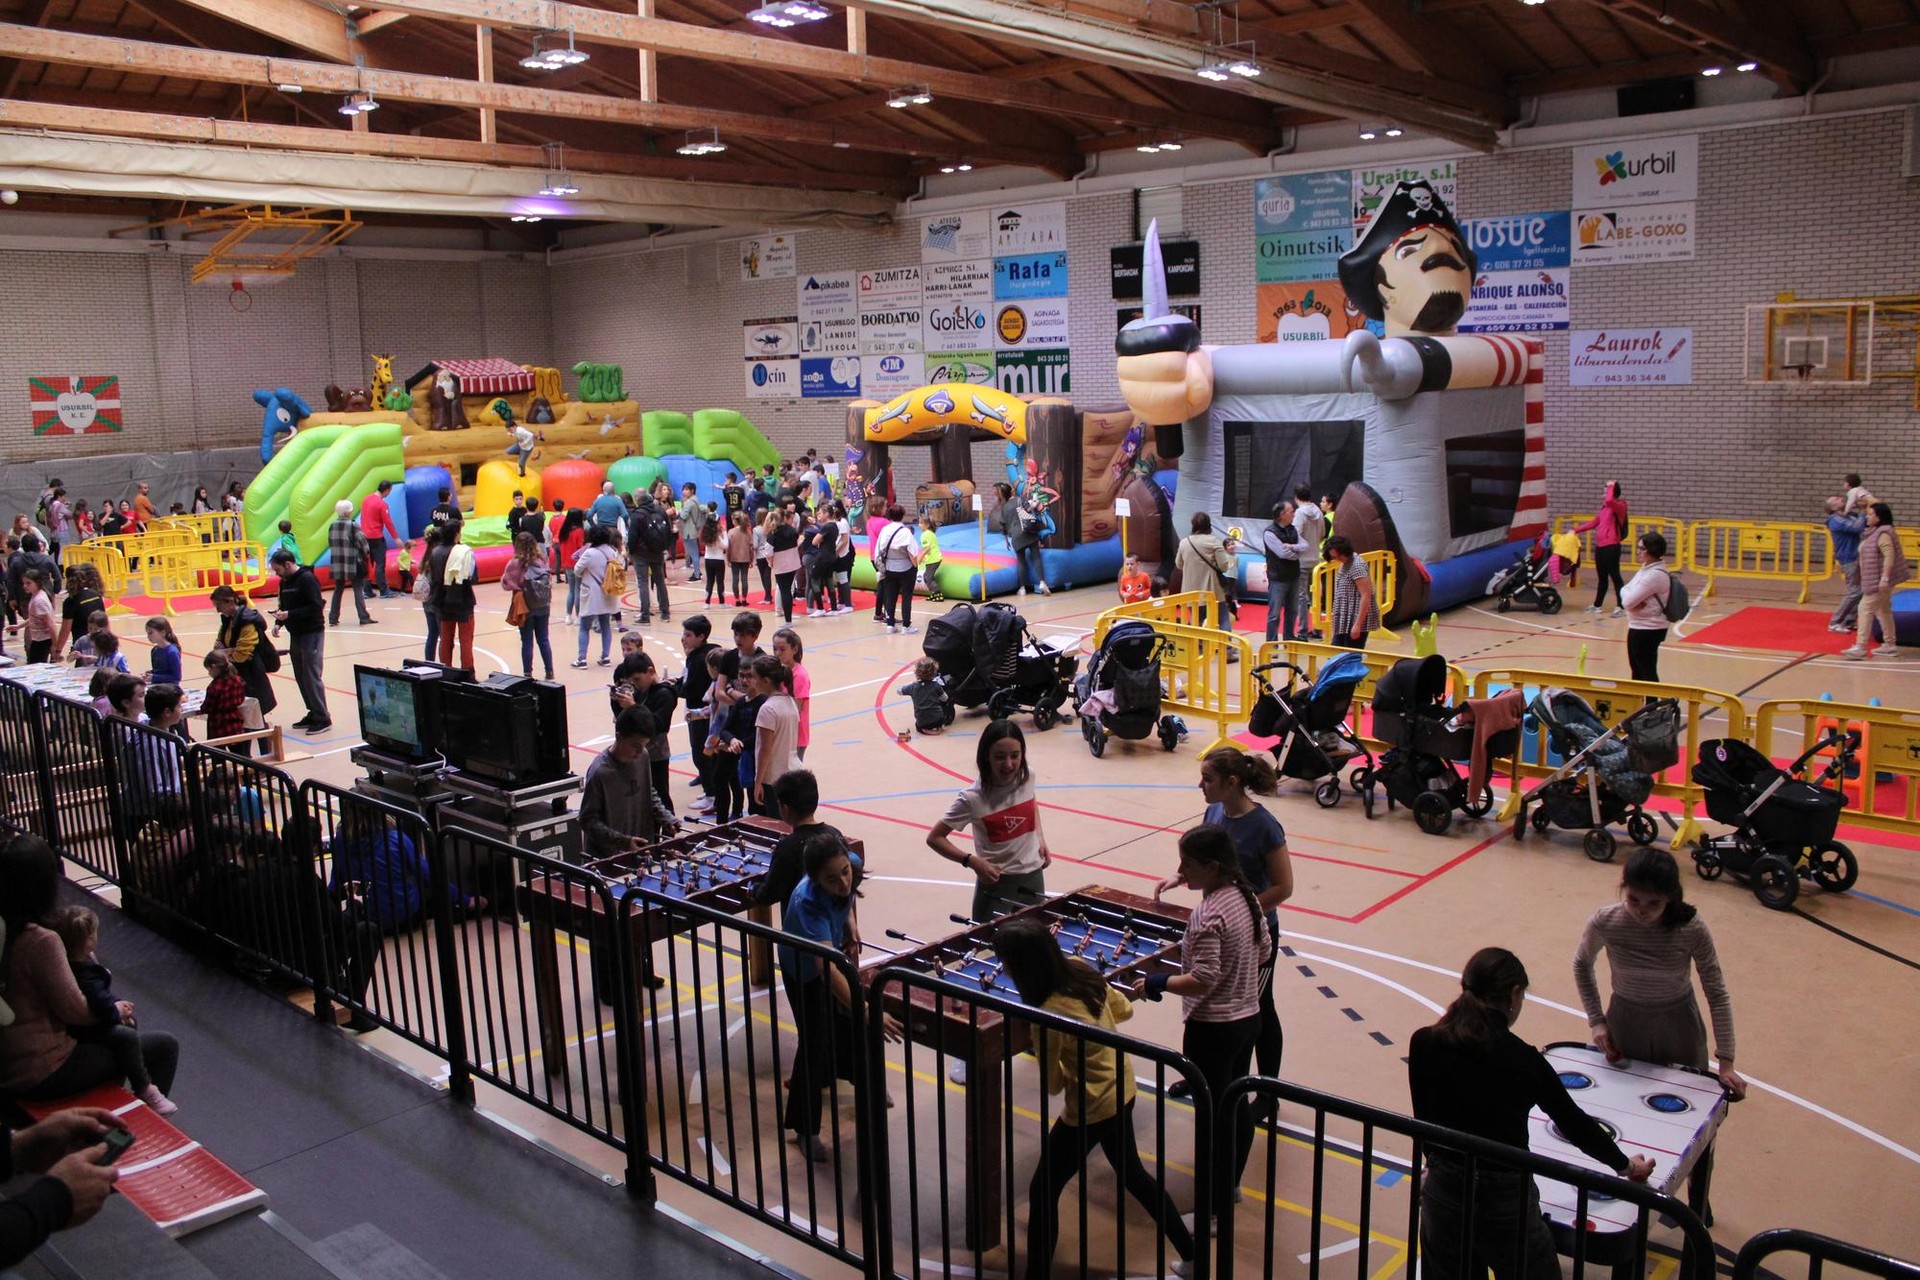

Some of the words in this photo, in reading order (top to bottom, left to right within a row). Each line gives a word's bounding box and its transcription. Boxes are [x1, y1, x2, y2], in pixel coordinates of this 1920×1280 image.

[1628, 151, 1675, 176] urbil
[1442, 185, 1454, 194] 92
[1596, 223, 1687, 241] LABE-GOXO
[1260, 235, 1345, 258] Oinutsik
[874, 269, 920, 283] ZUMITZA
[950, 272, 989, 282] HILARRIAK
[1009, 261, 1050, 280] Rafa
[1471, 286, 1513, 300] NRIQUE
[1517, 283, 1564, 298] ALONSO
[1273, 300, 1297, 320] 1963
[1504, 303, 1517, 311] GAS
[861, 311, 920, 326] BORDATXO
[1486, 324, 1506, 332] 659
[1508, 323, 1522, 331] 67
[1282, 332, 1326, 341] USURBIL
[1585, 331, 1662, 353] Laurok
[825, 344, 857, 352] ESKOLA
[882, 359, 901, 371] JM
[998, 363, 1069, 393] mur
[1605, 374, 1622, 382] 943
